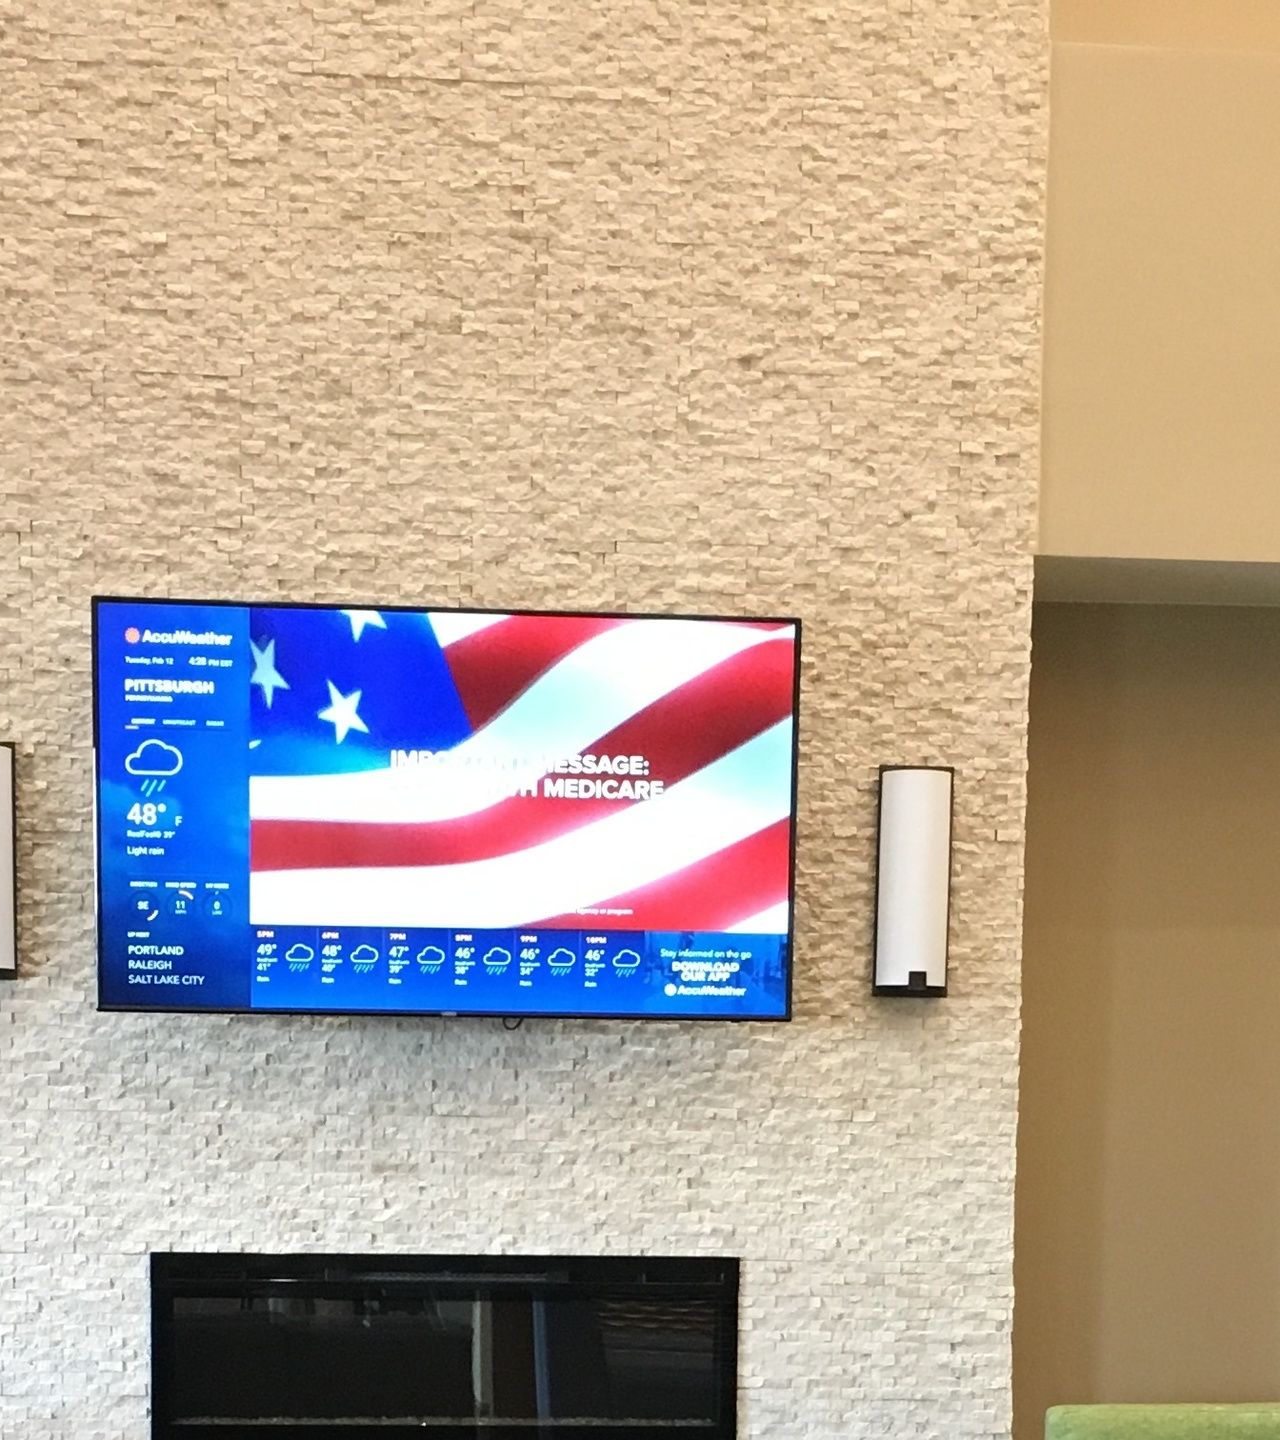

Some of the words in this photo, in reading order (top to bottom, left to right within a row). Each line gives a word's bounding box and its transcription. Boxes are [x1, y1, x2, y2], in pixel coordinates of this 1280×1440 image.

[142, 629, 232, 645] AccuWeather
[124, 679, 215, 694] PITTSBURGH
[544, 778, 664, 799] MEDICARE
[175, 815, 183, 827] F
[127, 846, 147, 856] Light
[149, 847, 165, 856] rain
[128, 945, 184, 955] PORTLAND
[661, 948, 677, 959] Stay
[128, 960, 172, 970] RALEIGH
[672, 961, 740, 972] DOWNLOAD
[128, 974, 152, 984] SALT
[154, 975, 180, 985] LAKE
[181, 975, 206, 985] CITY
[708, 971, 730, 981] APP
